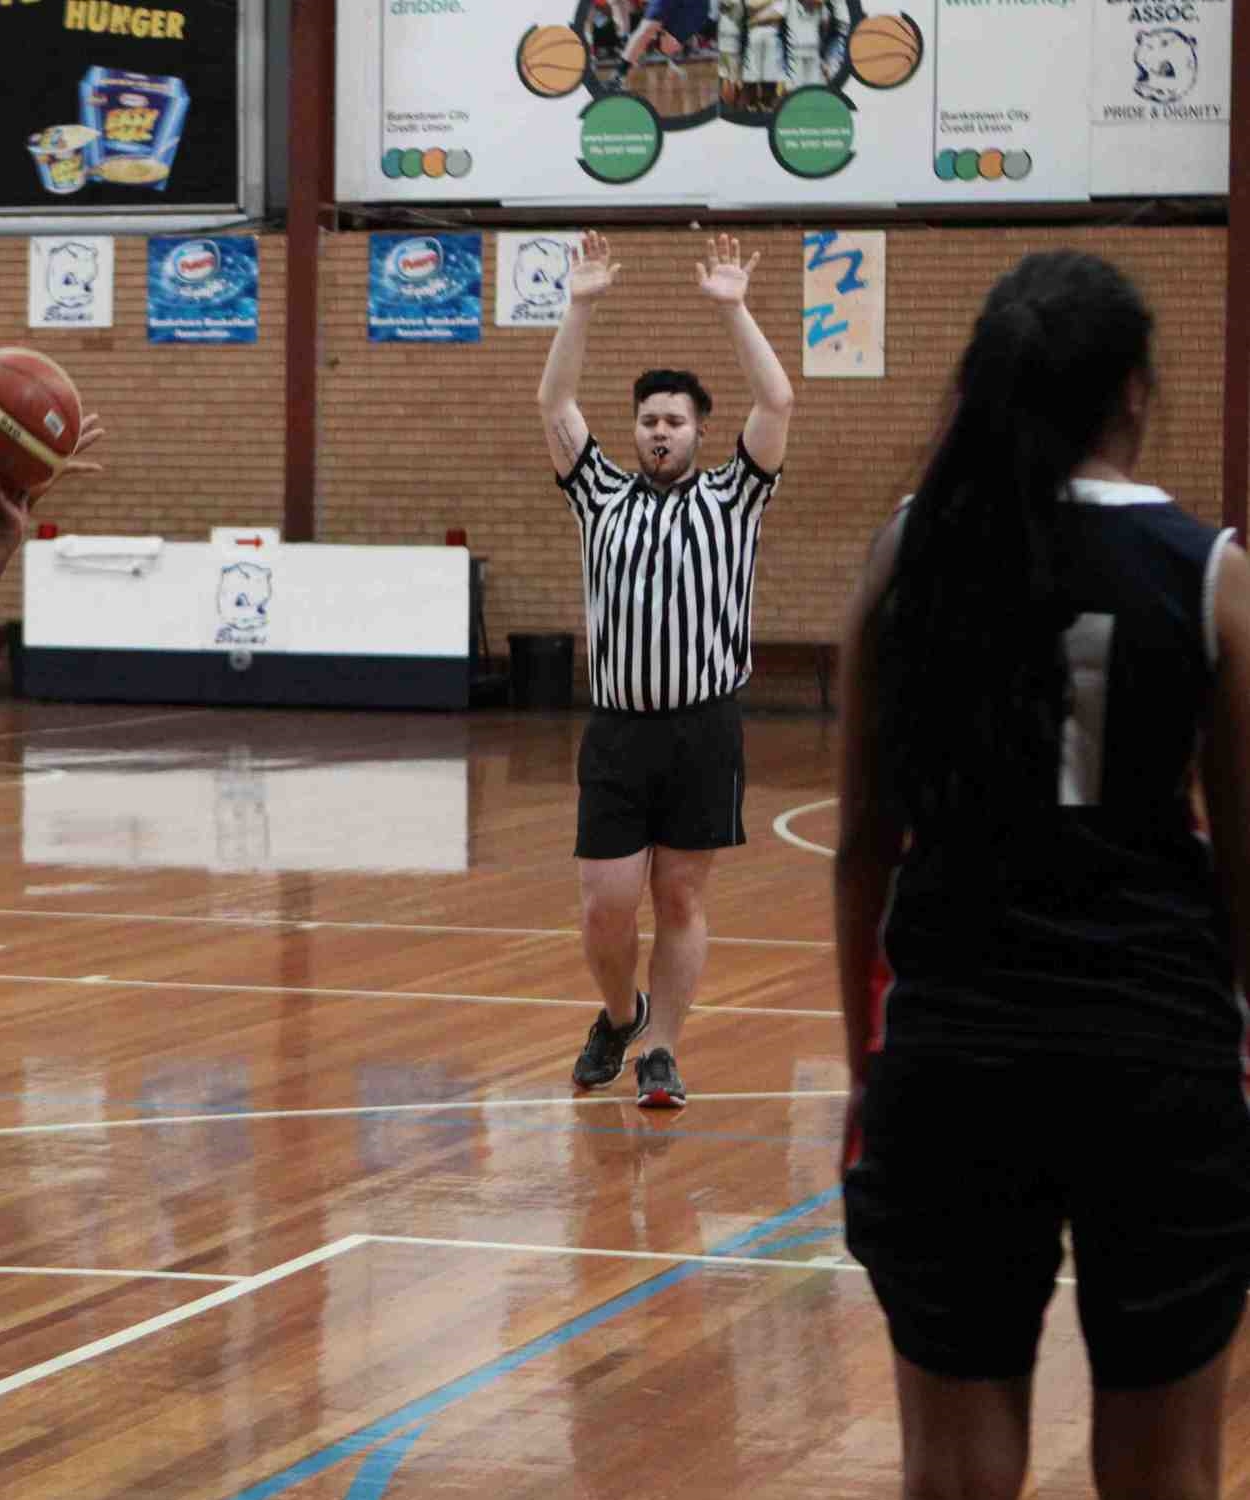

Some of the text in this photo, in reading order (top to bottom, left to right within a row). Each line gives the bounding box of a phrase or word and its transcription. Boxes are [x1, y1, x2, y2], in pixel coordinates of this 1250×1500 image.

[64, 0, 186, 39] HUNGER
[1128, 4, 1200, 23] ASSOC.
[448, 109, 471, 123] City
[1006, 108, 1030, 123] City
[1102, 104, 1223, 120] PRIDE & DIGNITY
